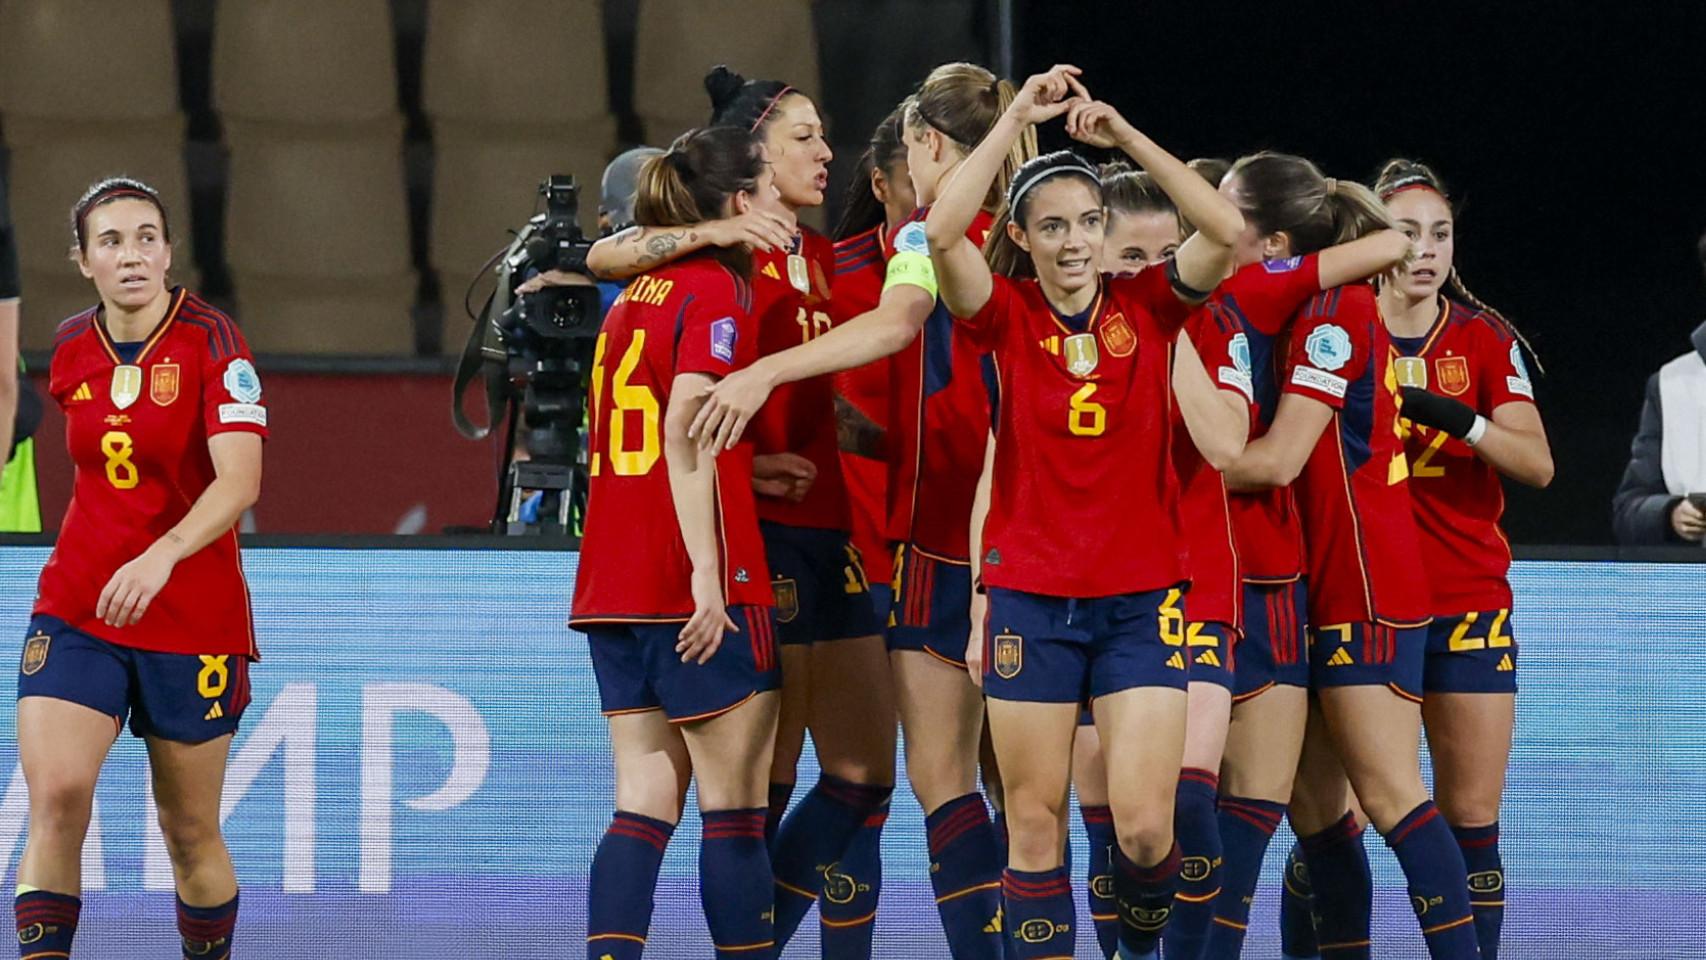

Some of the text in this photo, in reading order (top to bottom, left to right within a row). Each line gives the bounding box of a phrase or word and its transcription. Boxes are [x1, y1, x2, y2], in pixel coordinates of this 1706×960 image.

[590, 329, 660, 477] 16
[1068, 382, 1107, 437] 6
[101, 431, 139, 490] 8
[1158, 588, 1186, 647] 6
[1448, 608, 1512, 652] 22
[197, 654, 229, 699] 8
